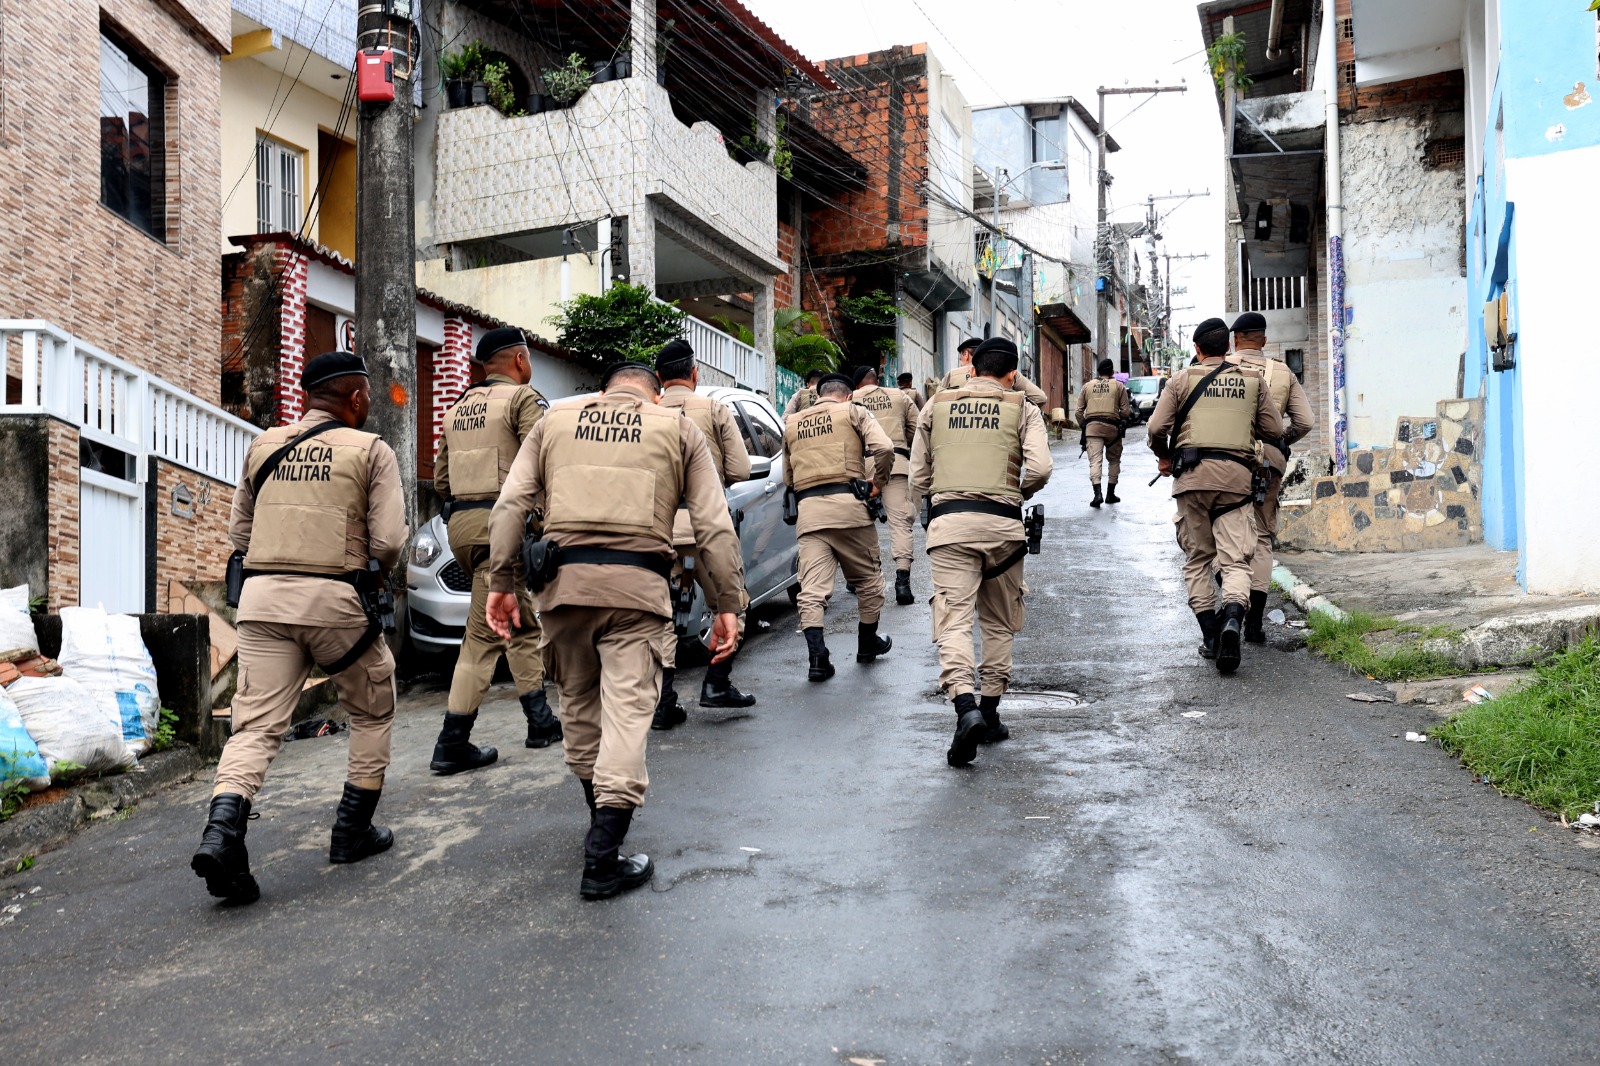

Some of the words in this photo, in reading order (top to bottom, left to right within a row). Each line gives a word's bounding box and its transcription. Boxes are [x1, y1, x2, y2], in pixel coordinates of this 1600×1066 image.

[1211, 376, 1246, 388] OLÍCIA
[1203, 387, 1246, 399] MILITAR
[455, 402, 487, 417] POLÍCIA
[949, 401, 1001, 416] POLÍCIA
[452, 415, 486, 431] MILITAR
[578, 409, 642, 427] POLÍCIA
[797, 414, 832, 430] POLÍCIA
[948, 417, 1000, 430] MILITAR
[574, 424, 642, 443] MILITAR
[797, 423, 833, 440] MILITAR
[284, 444, 333, 463] OLÍCIA
[272, 464, 332, 482] MILITAR
